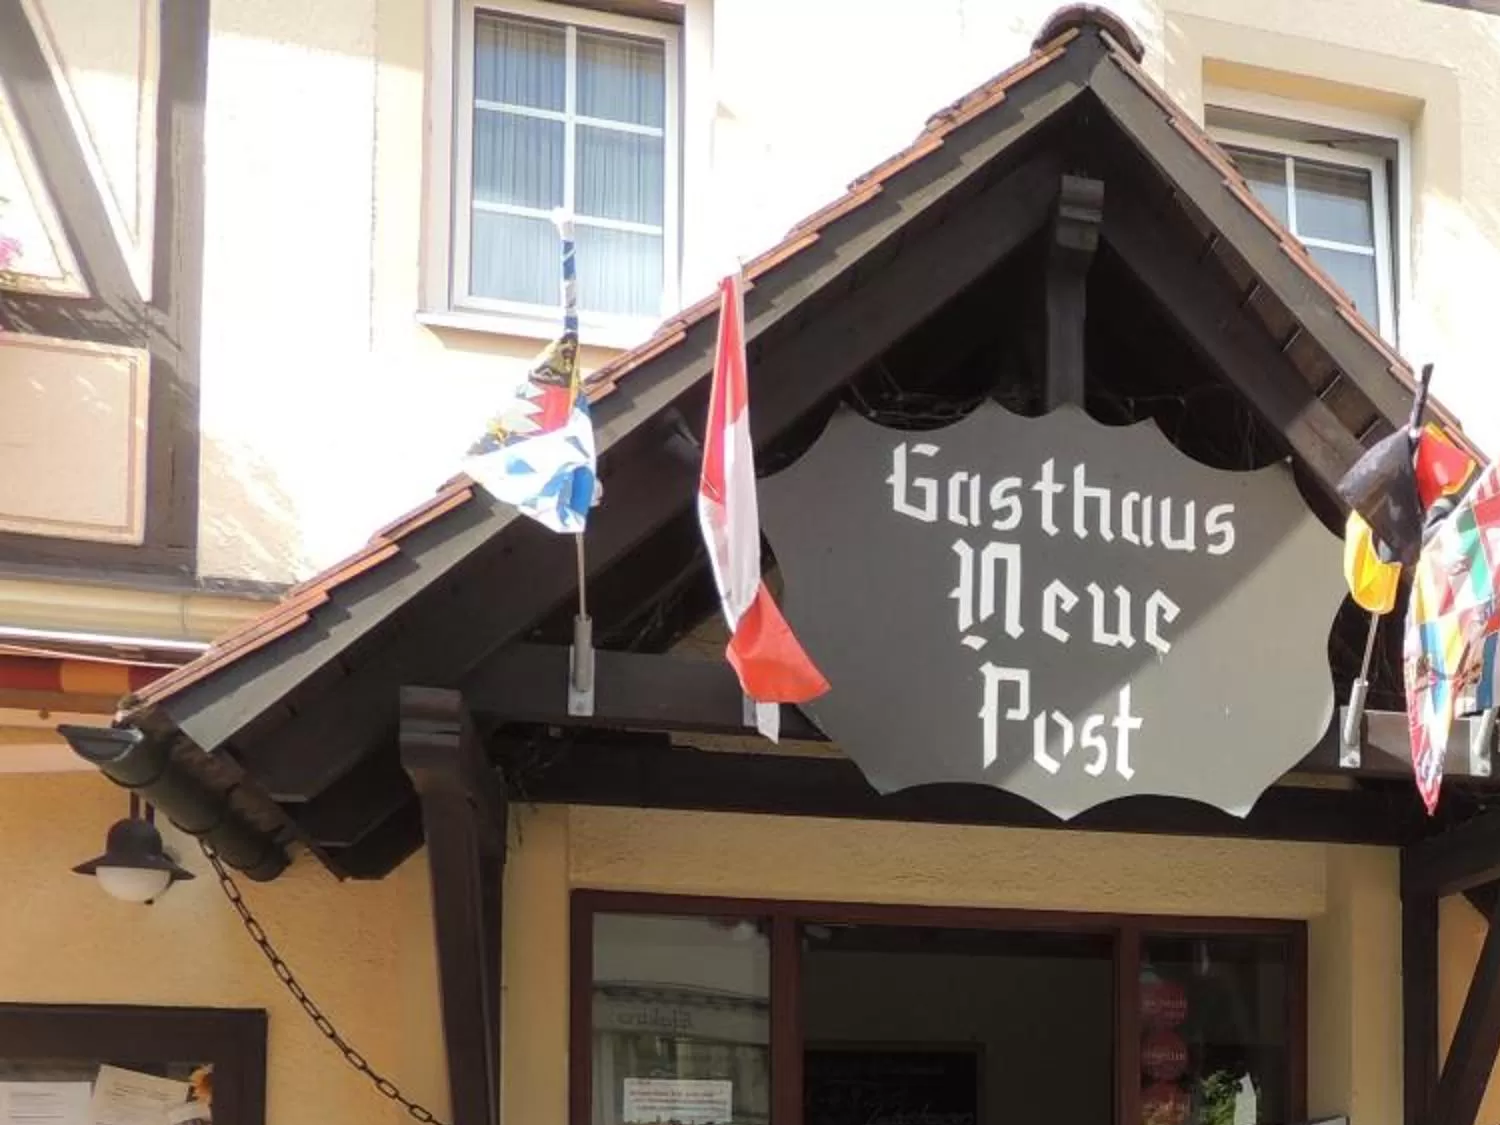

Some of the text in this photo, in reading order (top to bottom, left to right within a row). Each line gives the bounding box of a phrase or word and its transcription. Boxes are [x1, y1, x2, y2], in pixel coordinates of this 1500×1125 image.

[886, 441, 1235, 555] Gasthaus
[949, 539, 1181, 653] Neue
[978, 660, 1142, 781] Post
